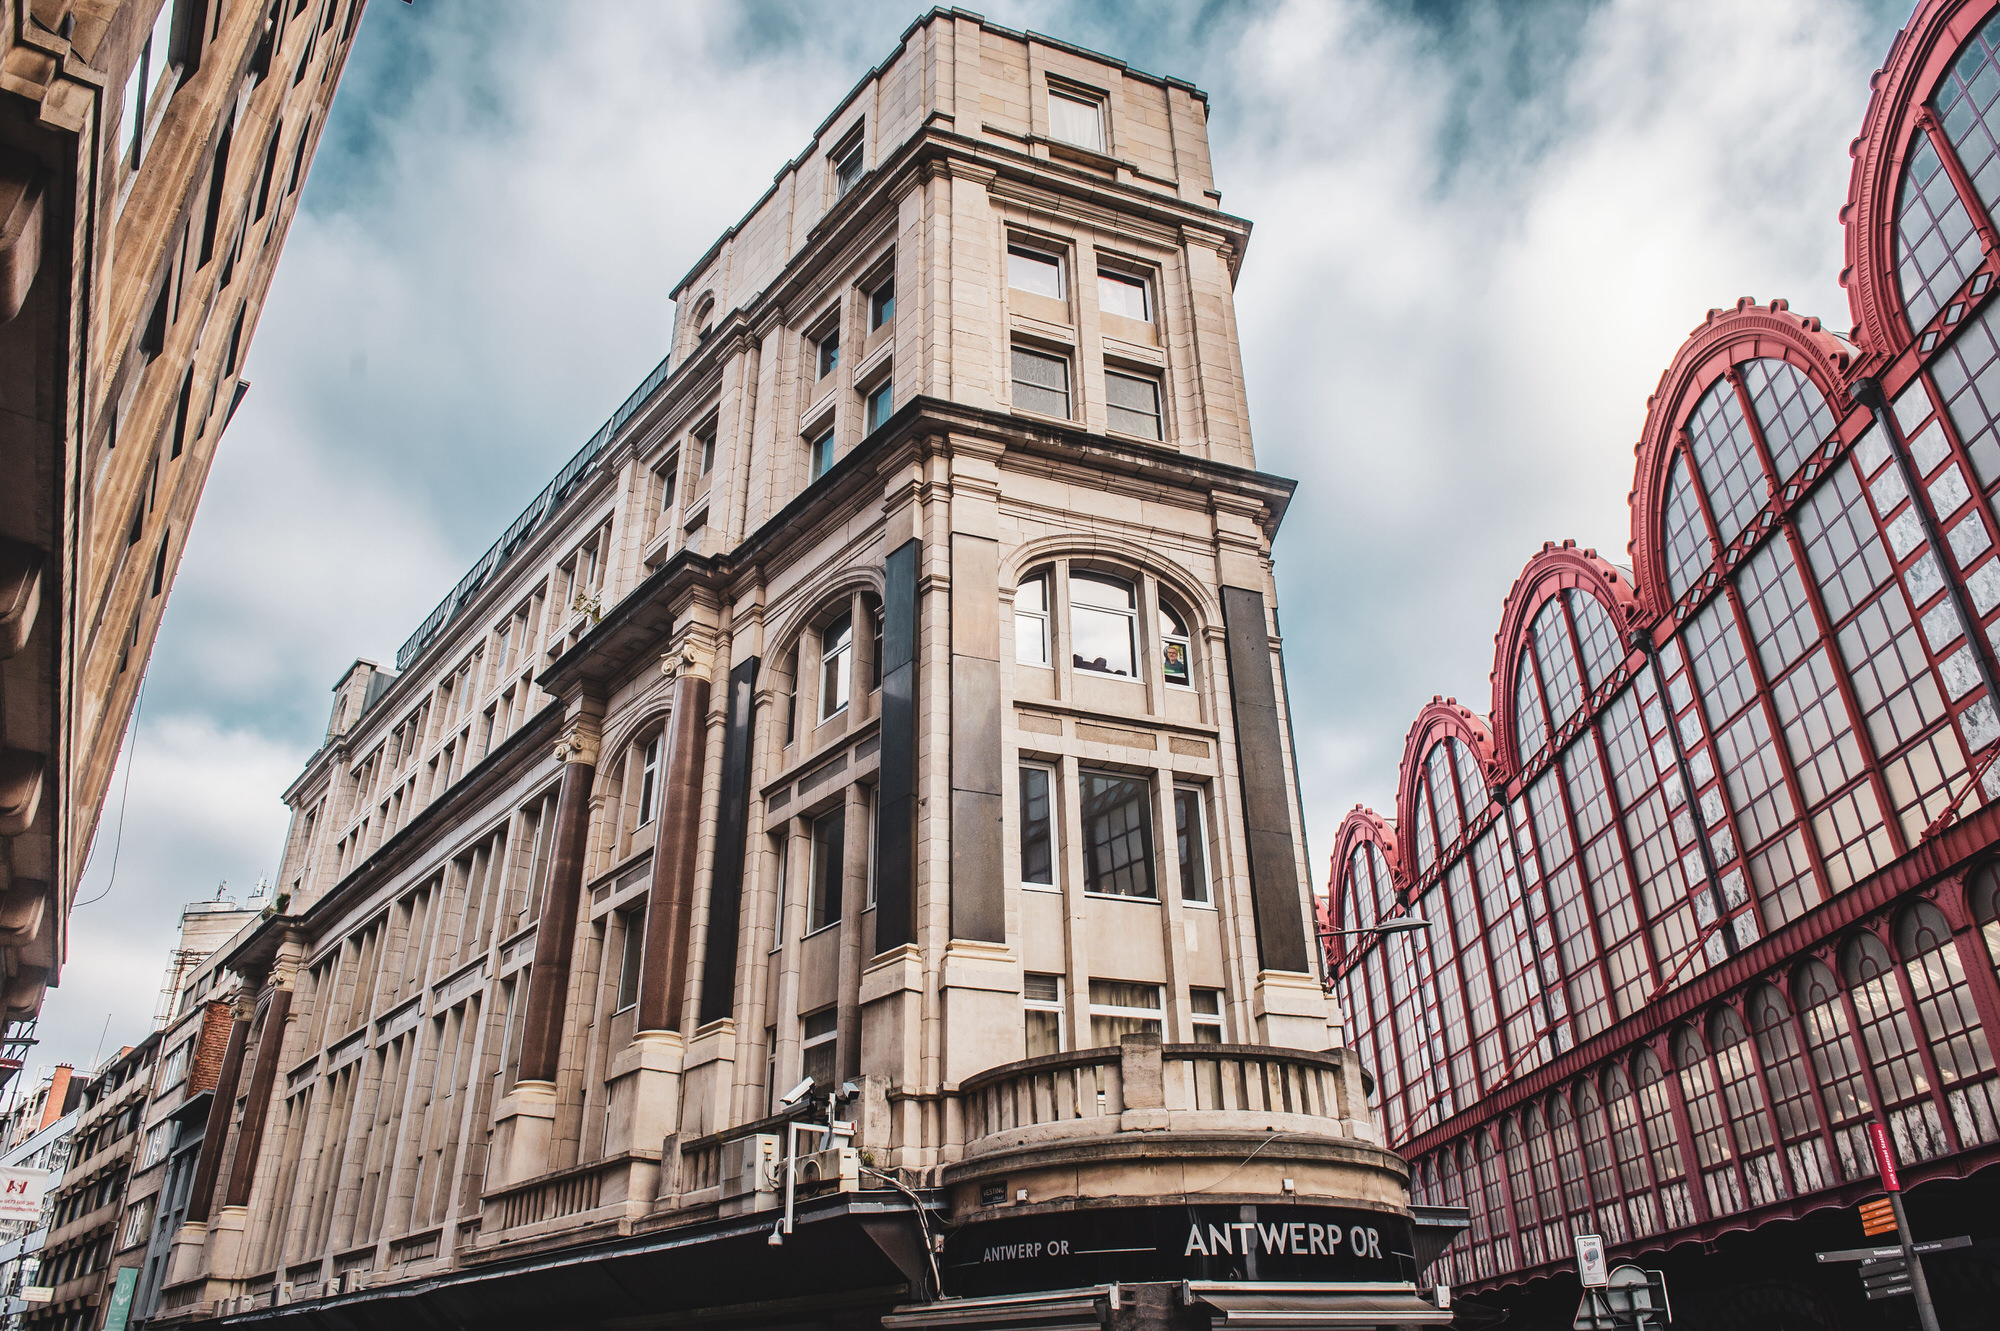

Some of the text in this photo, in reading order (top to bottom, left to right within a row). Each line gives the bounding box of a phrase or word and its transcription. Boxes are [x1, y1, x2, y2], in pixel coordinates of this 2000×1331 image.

[1877, 1129, 1887, 1149] Station
[1882, 1150, 1893, 1173] Centraal
[983, 1240, 1070, 1263] ANTWERP OR
[1184, 1222, 1384, 1260] ANTWERP OR
